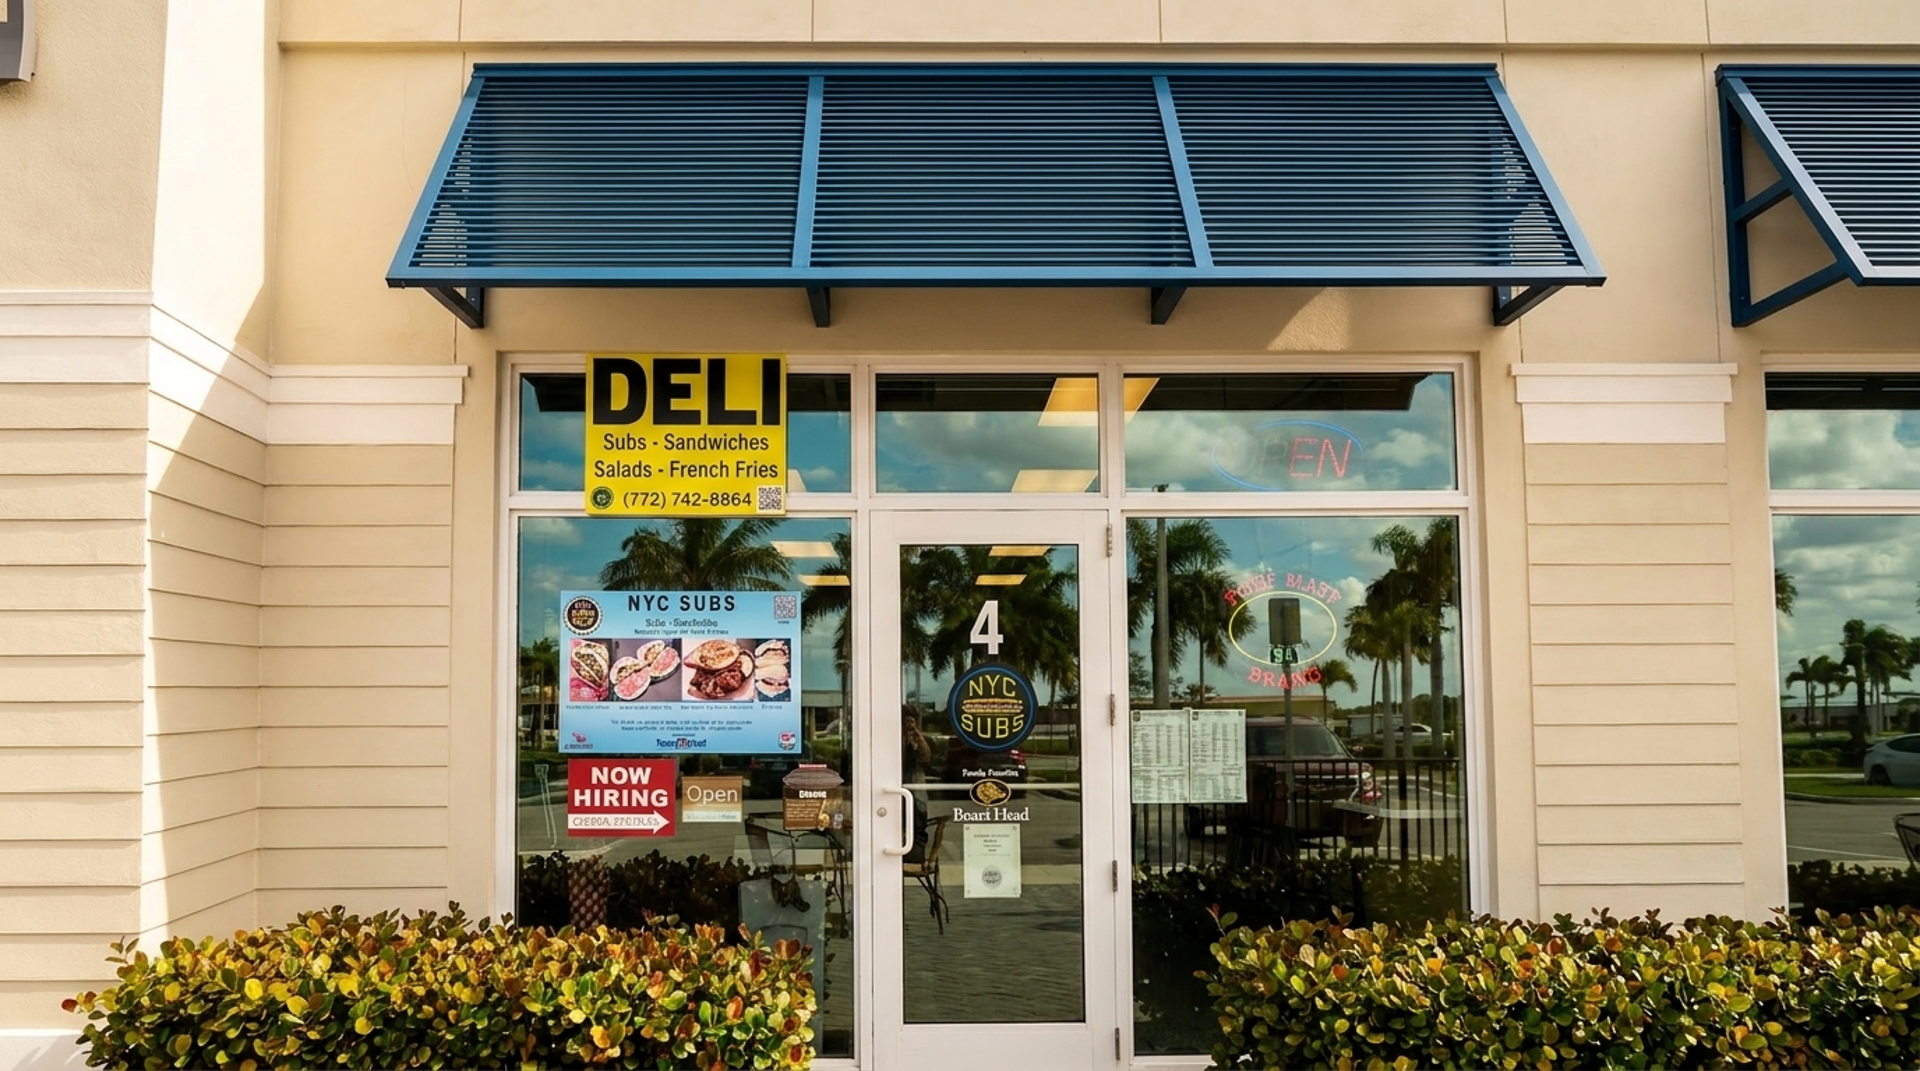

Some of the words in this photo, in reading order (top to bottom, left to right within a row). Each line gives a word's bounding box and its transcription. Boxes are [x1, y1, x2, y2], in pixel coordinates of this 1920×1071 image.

[593, 358, 780, 425] DELI
[603, 433, 647, 450] Subs
[664, 433, 769, 450] Sandwiches
[594, 460, 652, 477] Salads
[670, 460, 729, 477] French
[736, 460, 778, 477] Fries
[623, 491, 667, 509] (772)
[673, 491, 751, 507] 742-8864
[629, 595, 669, 611] NYC
[680, 595, 735, 611] SUBS
[970, 600, 1003, 655] 4
[969, 675, 1016, 697] NYC
[961, 713, 1024, 739] SUBS
[591, 766, 652, 784] NOW
[574, 789, 669, 807] HIRING
[686, 785, 738, 806] Open
[994, 806, 1030, 821] Head
